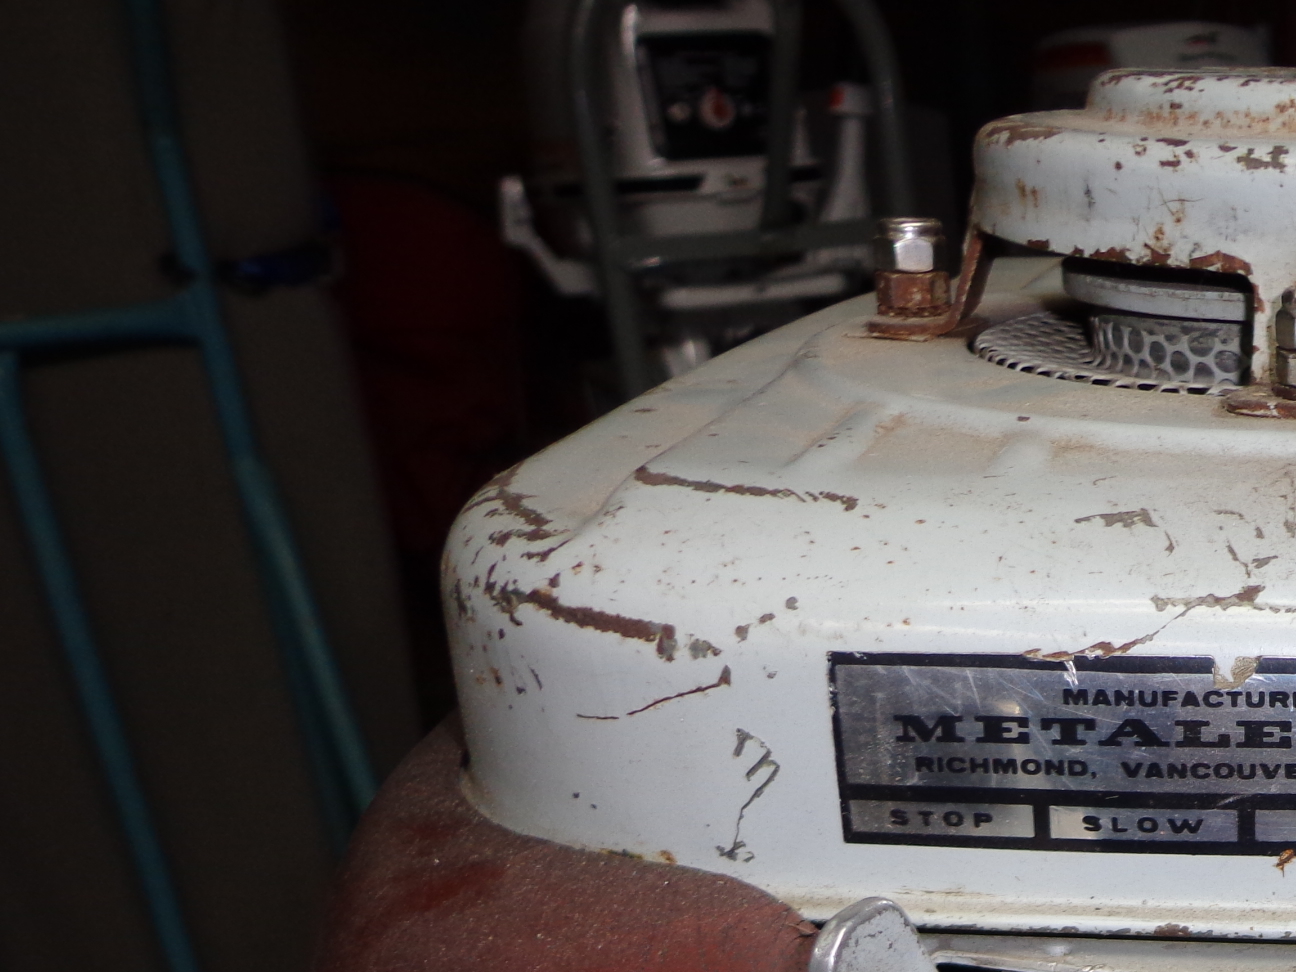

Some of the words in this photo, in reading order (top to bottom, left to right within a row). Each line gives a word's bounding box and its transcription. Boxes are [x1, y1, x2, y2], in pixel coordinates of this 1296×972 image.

[914, 756, 1097, 778] RICHMOND,
[890, 808, 994, 828] STOP
[1082, 813, 1205, 834] SLOW
